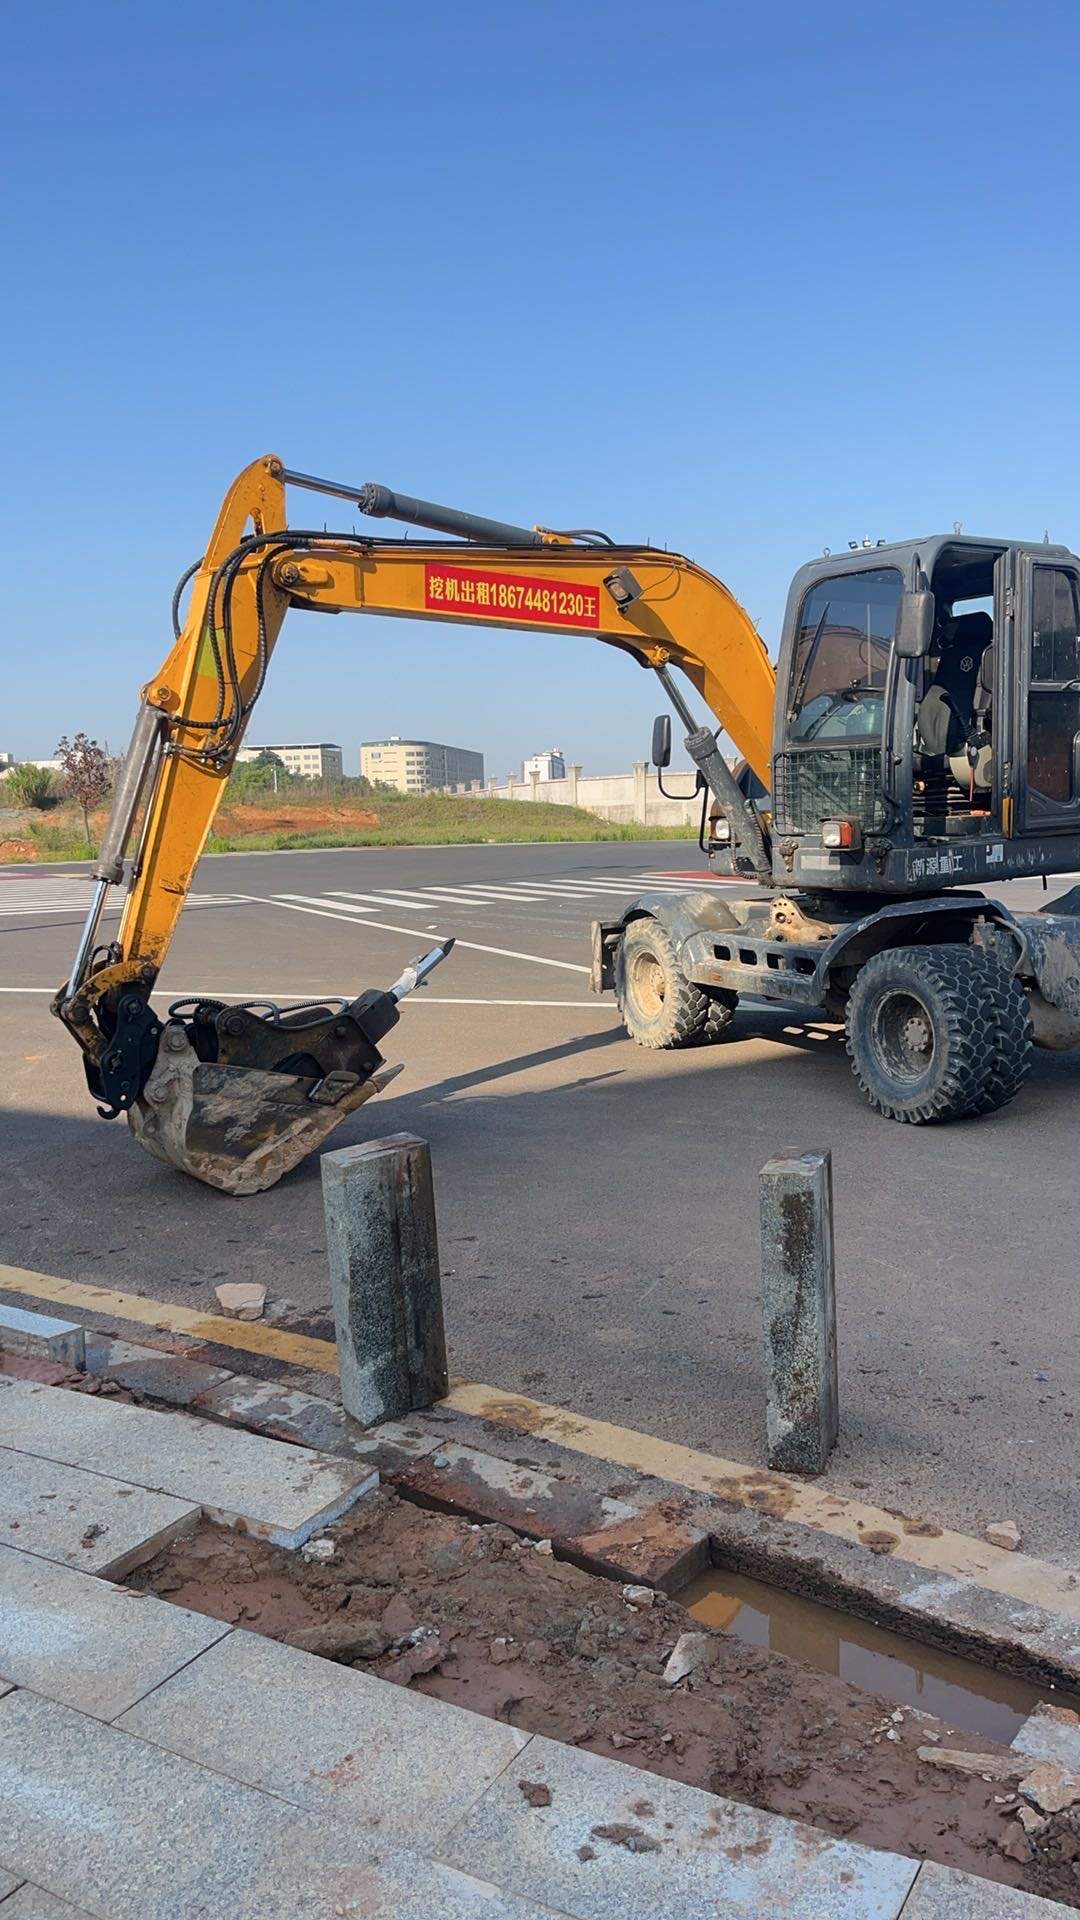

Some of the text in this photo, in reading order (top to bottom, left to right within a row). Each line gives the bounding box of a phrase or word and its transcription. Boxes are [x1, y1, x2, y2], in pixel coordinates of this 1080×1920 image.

[429, 576, 596, 617] 挖机出租18674481230王
